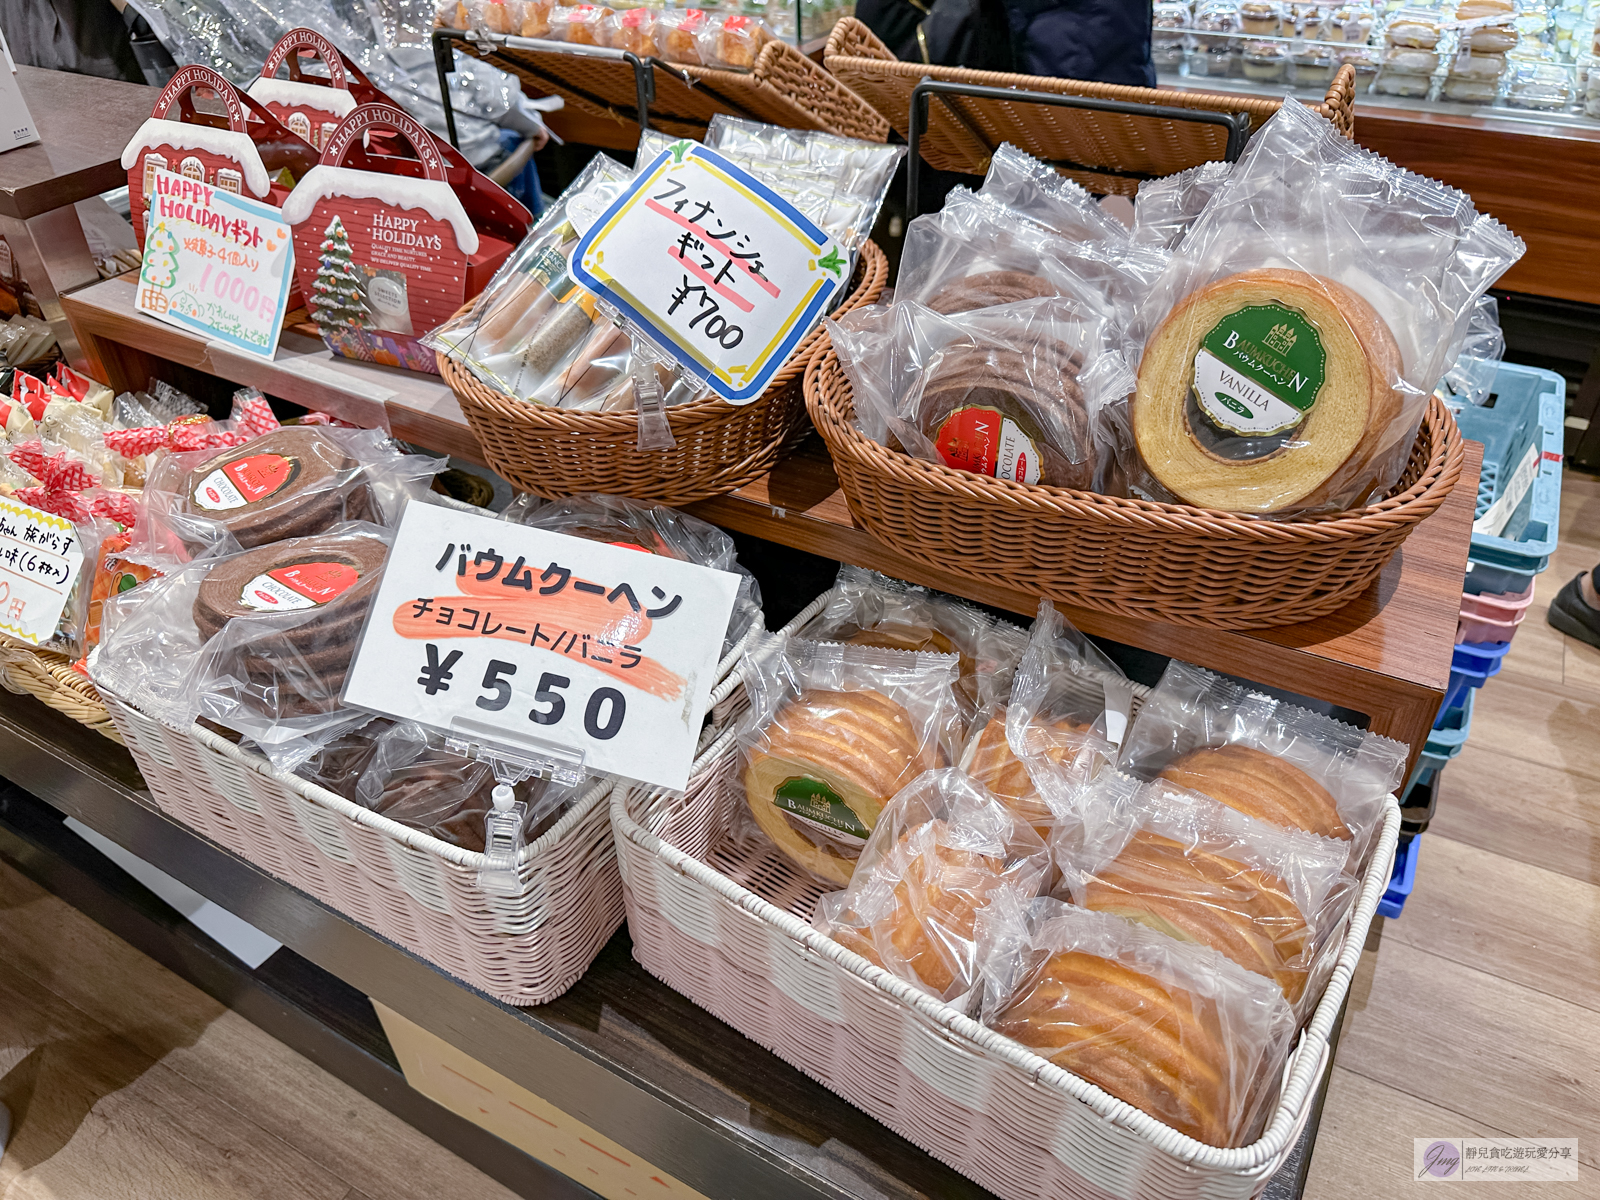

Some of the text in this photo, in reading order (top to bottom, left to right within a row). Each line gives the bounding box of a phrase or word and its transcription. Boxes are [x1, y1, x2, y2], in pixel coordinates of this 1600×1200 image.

[271, 31, 338, 71] HAPPY HOLIDAYS
[165, 69, 236, 113] HAPPY HOLIDAYS
[336, 109, 432, 159] HAPPY HOLIDAYS
[157, 174, 214, 207] HAPPY
[372, 228, 442, 250] HOLIDAYS
[373, 214, 419, 232] HAPPY
[653, 178, 769, 282] フィナンシェ
[677, 232, 736, 285] ギフト
[199, 263, 277, 323] 1000円
[667, 274, 745, 350] ¥700
[1222, 330, 1309, 393] BAUMKUCHEN
[1233, 350, 1286, 385] バウムクーヘン
[1220, 370, 1269, 411] VANILLA
[1221, 396, 1245, 414] バニラ
[214, 477, 239, 503] CHOCOLATE
[435, 543, 683, 619] バウムクーヘン
